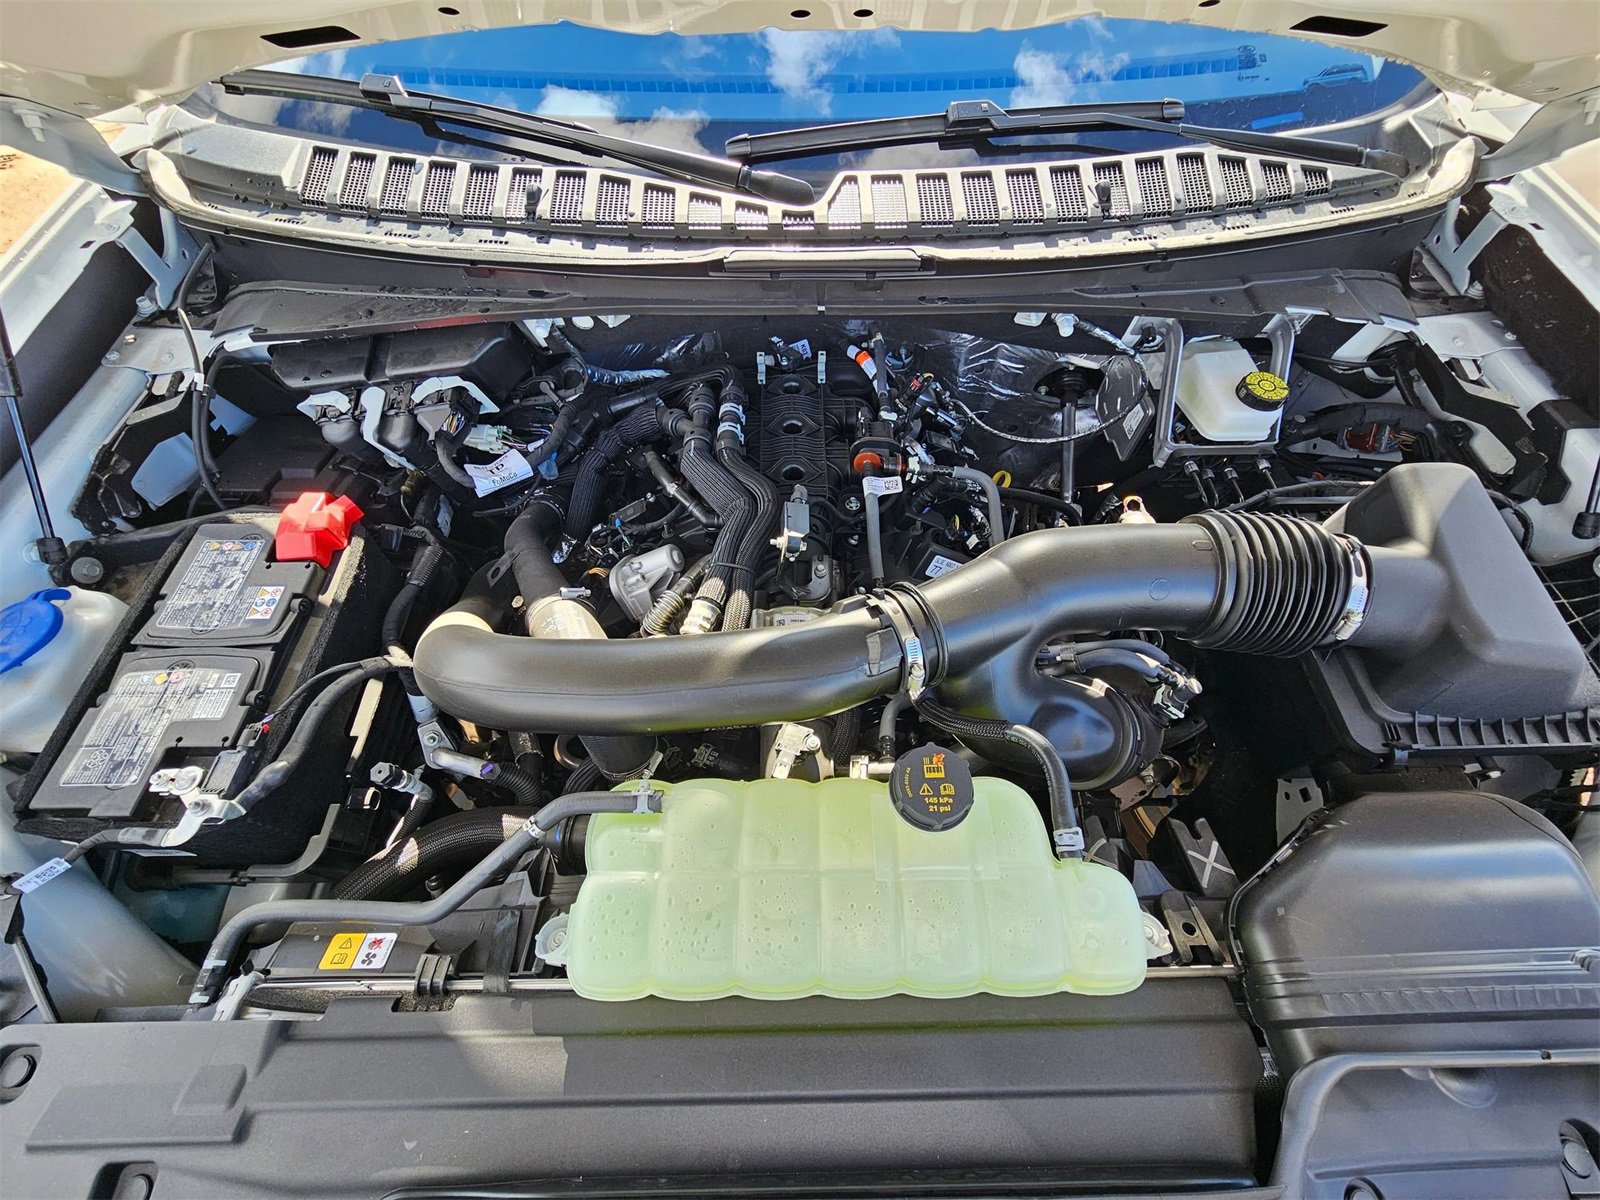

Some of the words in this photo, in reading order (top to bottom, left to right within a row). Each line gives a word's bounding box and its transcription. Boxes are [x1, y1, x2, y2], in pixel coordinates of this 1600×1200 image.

[491, 472, 518, 486] FoMoCo
[930, 564, 943, 575] 77
[924, 796, 938, 804] 145
[939, 796, 954, 804] kPa
[928, 804, 938, 812] 21
[939, 804, 951, 813] psi
